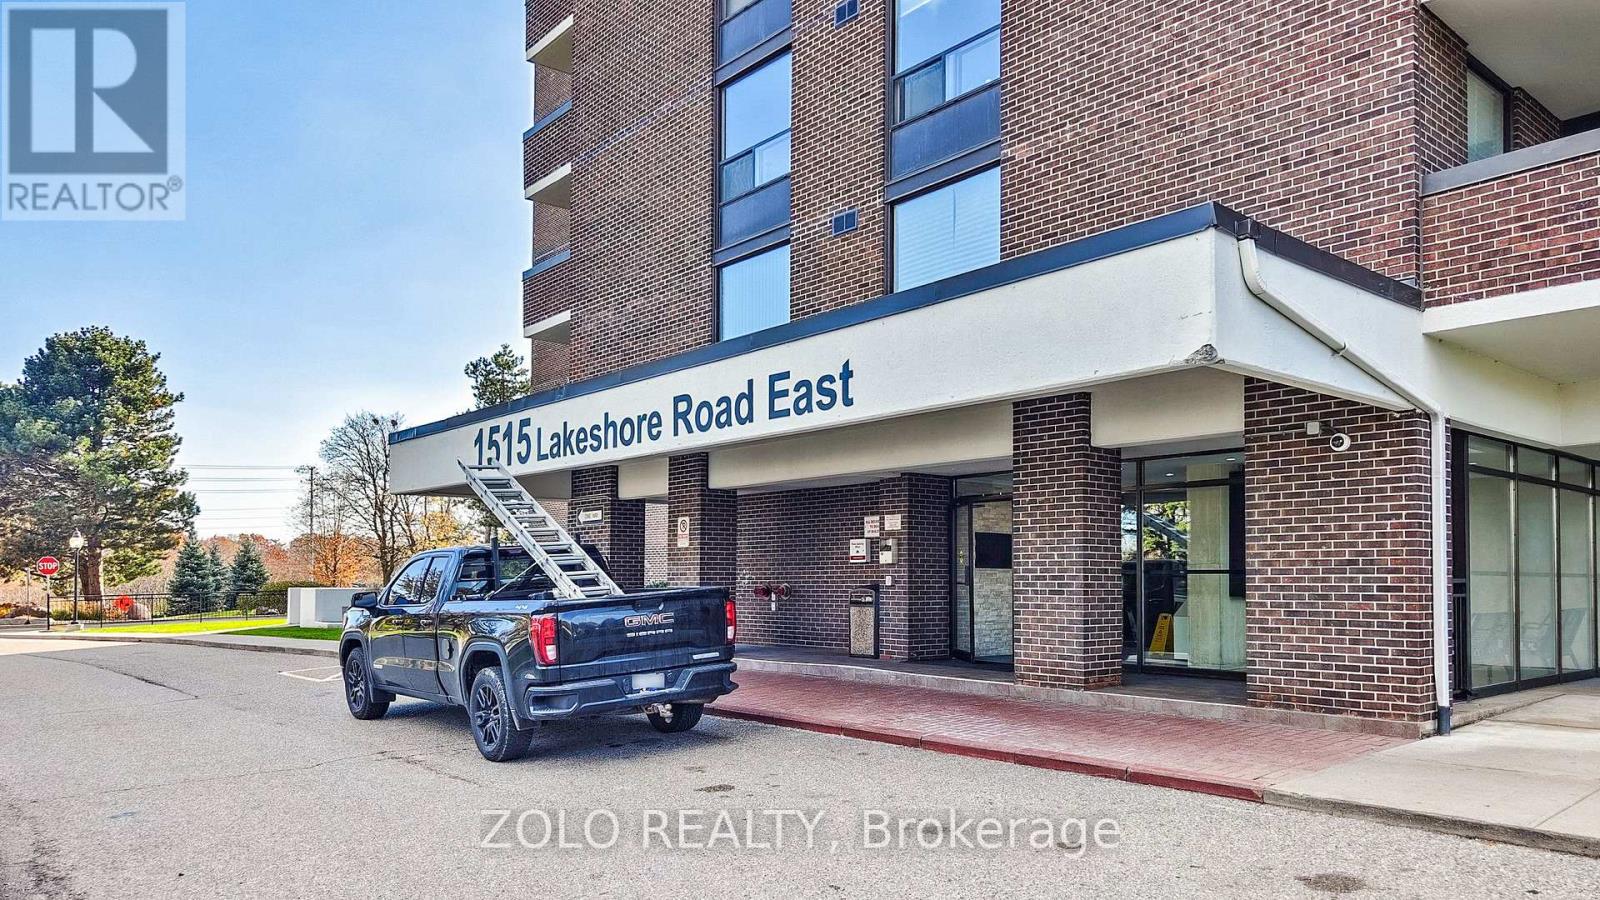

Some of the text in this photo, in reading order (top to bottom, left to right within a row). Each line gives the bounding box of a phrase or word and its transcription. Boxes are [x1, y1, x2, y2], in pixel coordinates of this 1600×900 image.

[473, 358, 854, 467] 1515 Lakeshore Road East
[38, 562, 58, 570] STOP
[624, 612, 675, 628] GMC
